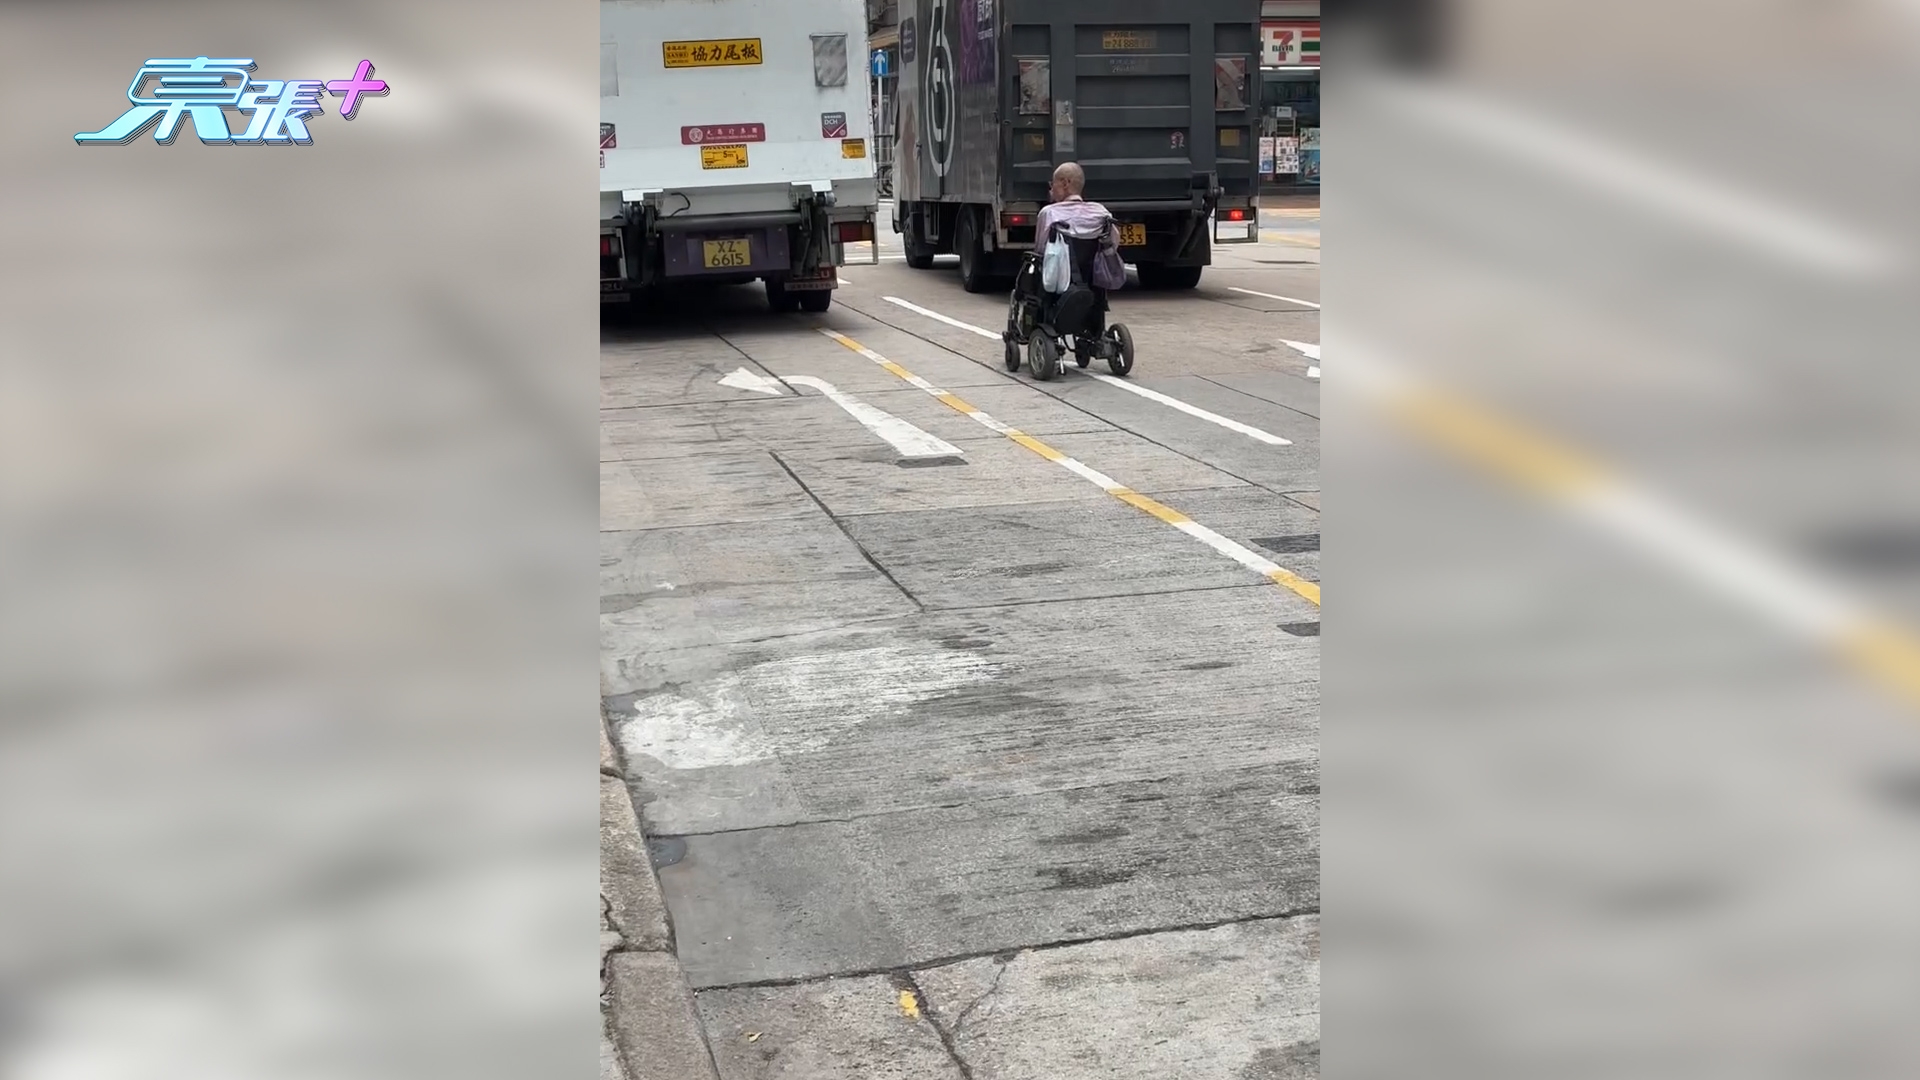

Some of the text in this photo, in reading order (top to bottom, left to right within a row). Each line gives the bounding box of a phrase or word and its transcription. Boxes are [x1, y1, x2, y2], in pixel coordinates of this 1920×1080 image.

[1273, 30, 1294, 61] 7
[690, 44, 760, 62] 協力尾板
[1119, 224, 1134, 235] TR
[1119, 234, 1143, 244] 553
[717, 241, 737, 253] XZ
[711, 253, 744, 266] 6615
